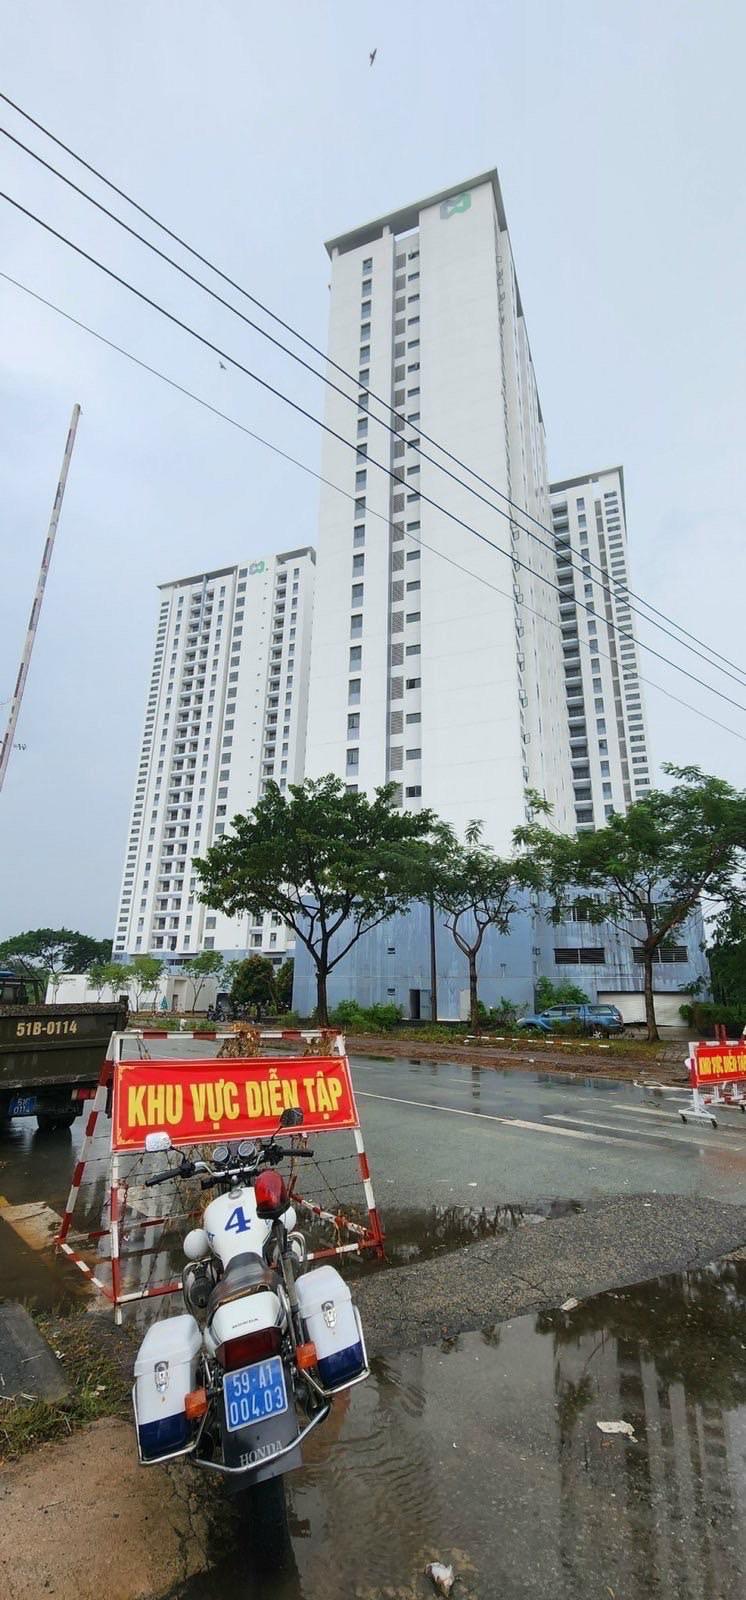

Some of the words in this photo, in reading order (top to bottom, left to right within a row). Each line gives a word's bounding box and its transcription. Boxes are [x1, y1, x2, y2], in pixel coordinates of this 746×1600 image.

[16, 1019, 78, 1037] 51B-0114
[127, 1084, 184, 1127] KHU
[190, 1078, 240, 1130] VỰC
[245, 1068, 300, 1119] DIỄN
[303, 1070, 343, 1120] TẬP
[224, 1205, 251, 1235] 4
[229, 1385, 283, 1425] 004.03
[239, 1440, 283, 1467] HONDA
